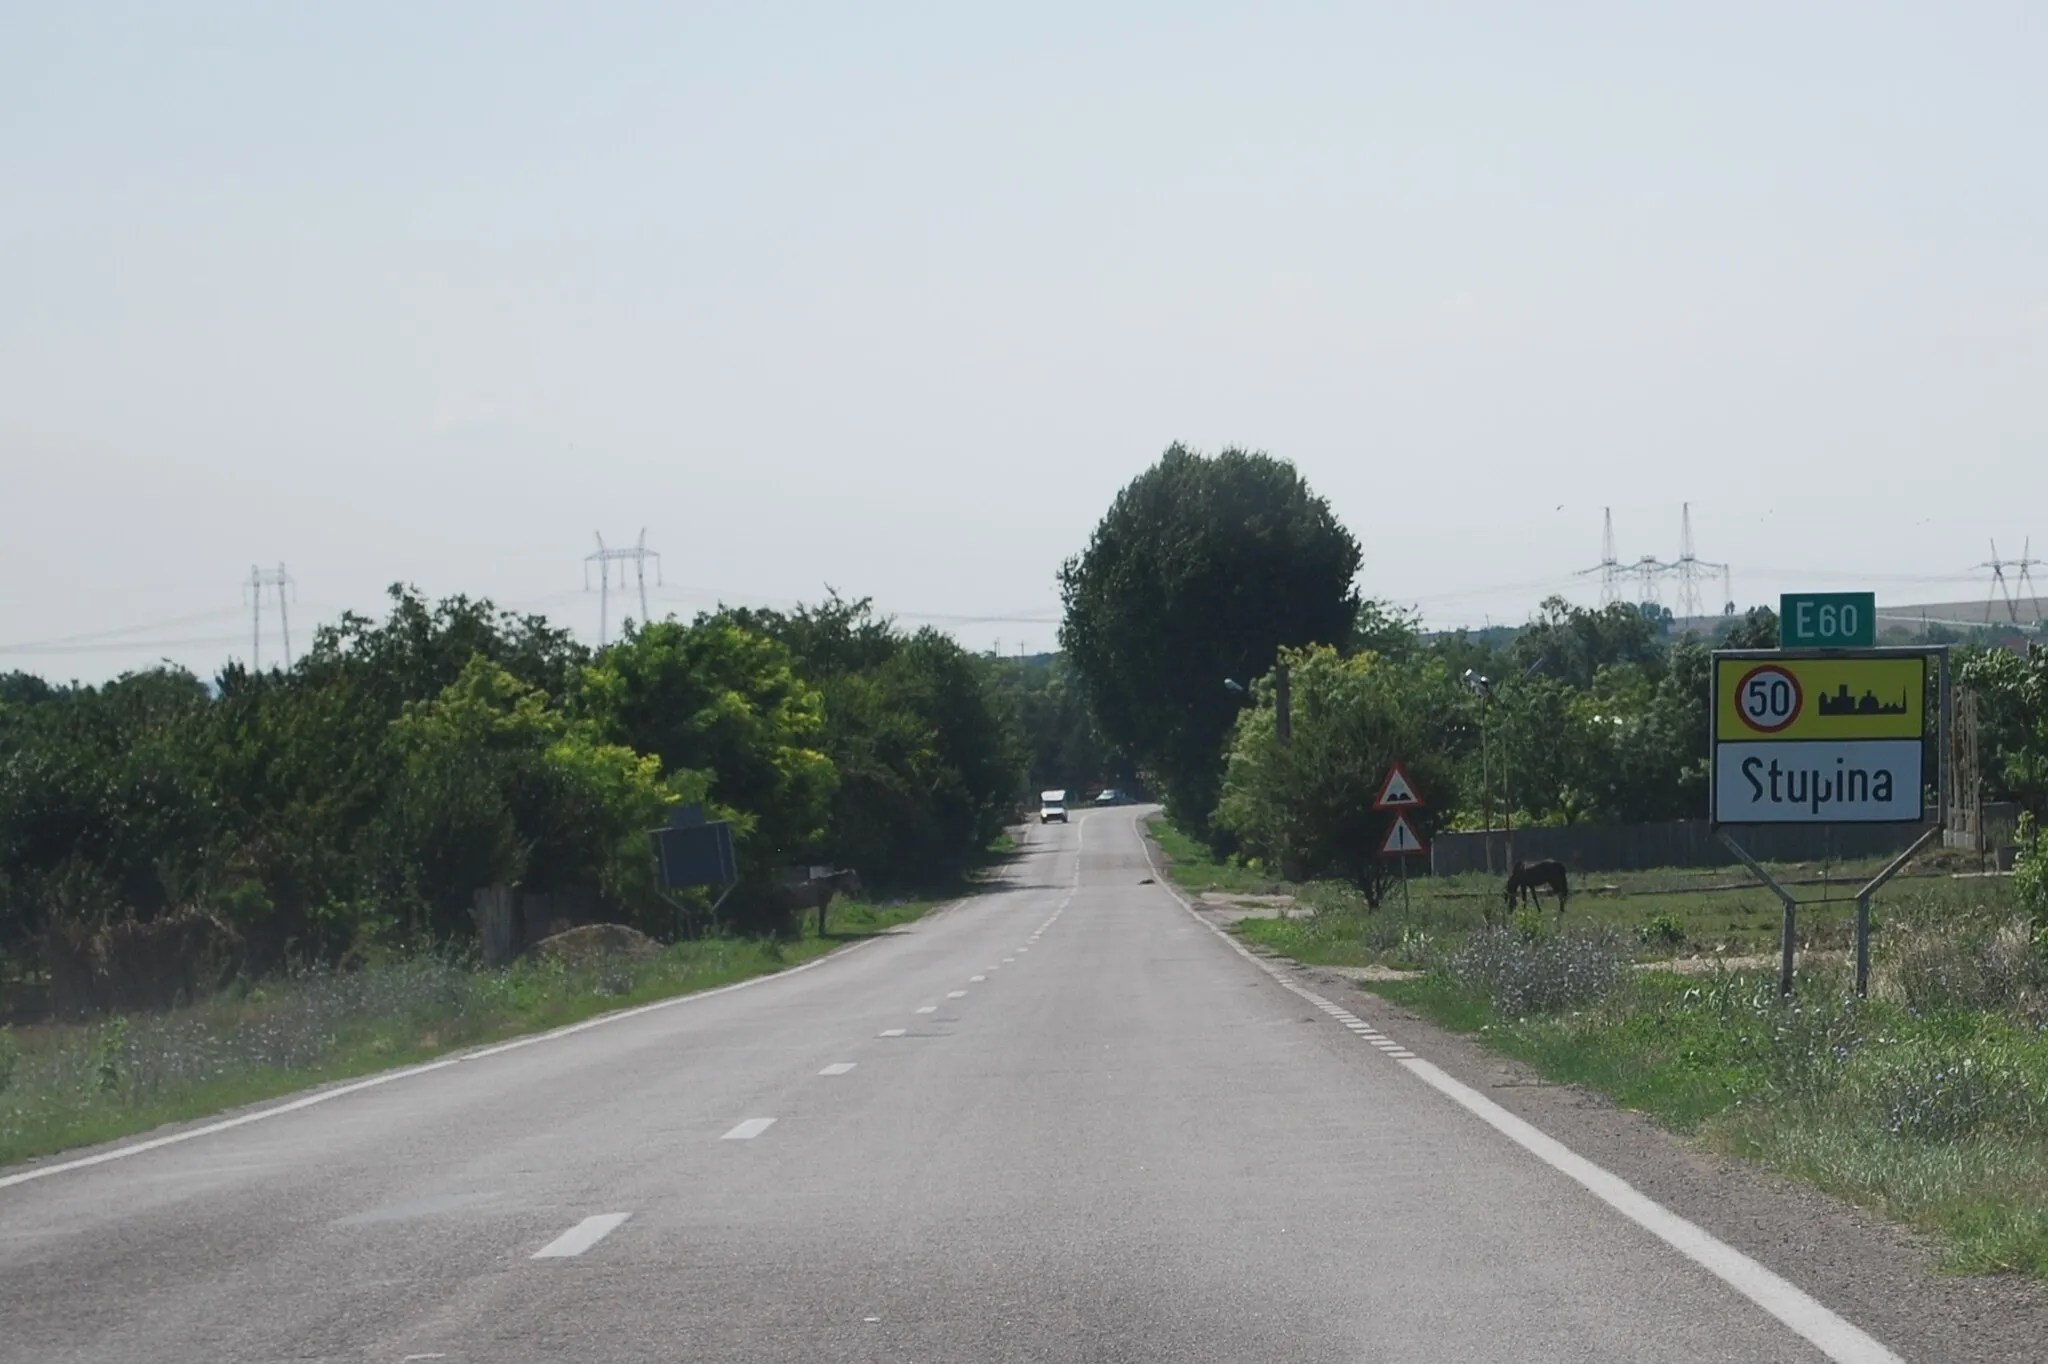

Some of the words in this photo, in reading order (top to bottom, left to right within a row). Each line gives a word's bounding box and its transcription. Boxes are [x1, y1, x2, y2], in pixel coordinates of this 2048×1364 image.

[1796, 601, 1858, 638] E60
[1748, 680, 1790, 717] 50
[1741, 756, 1893, 814] Stupina
